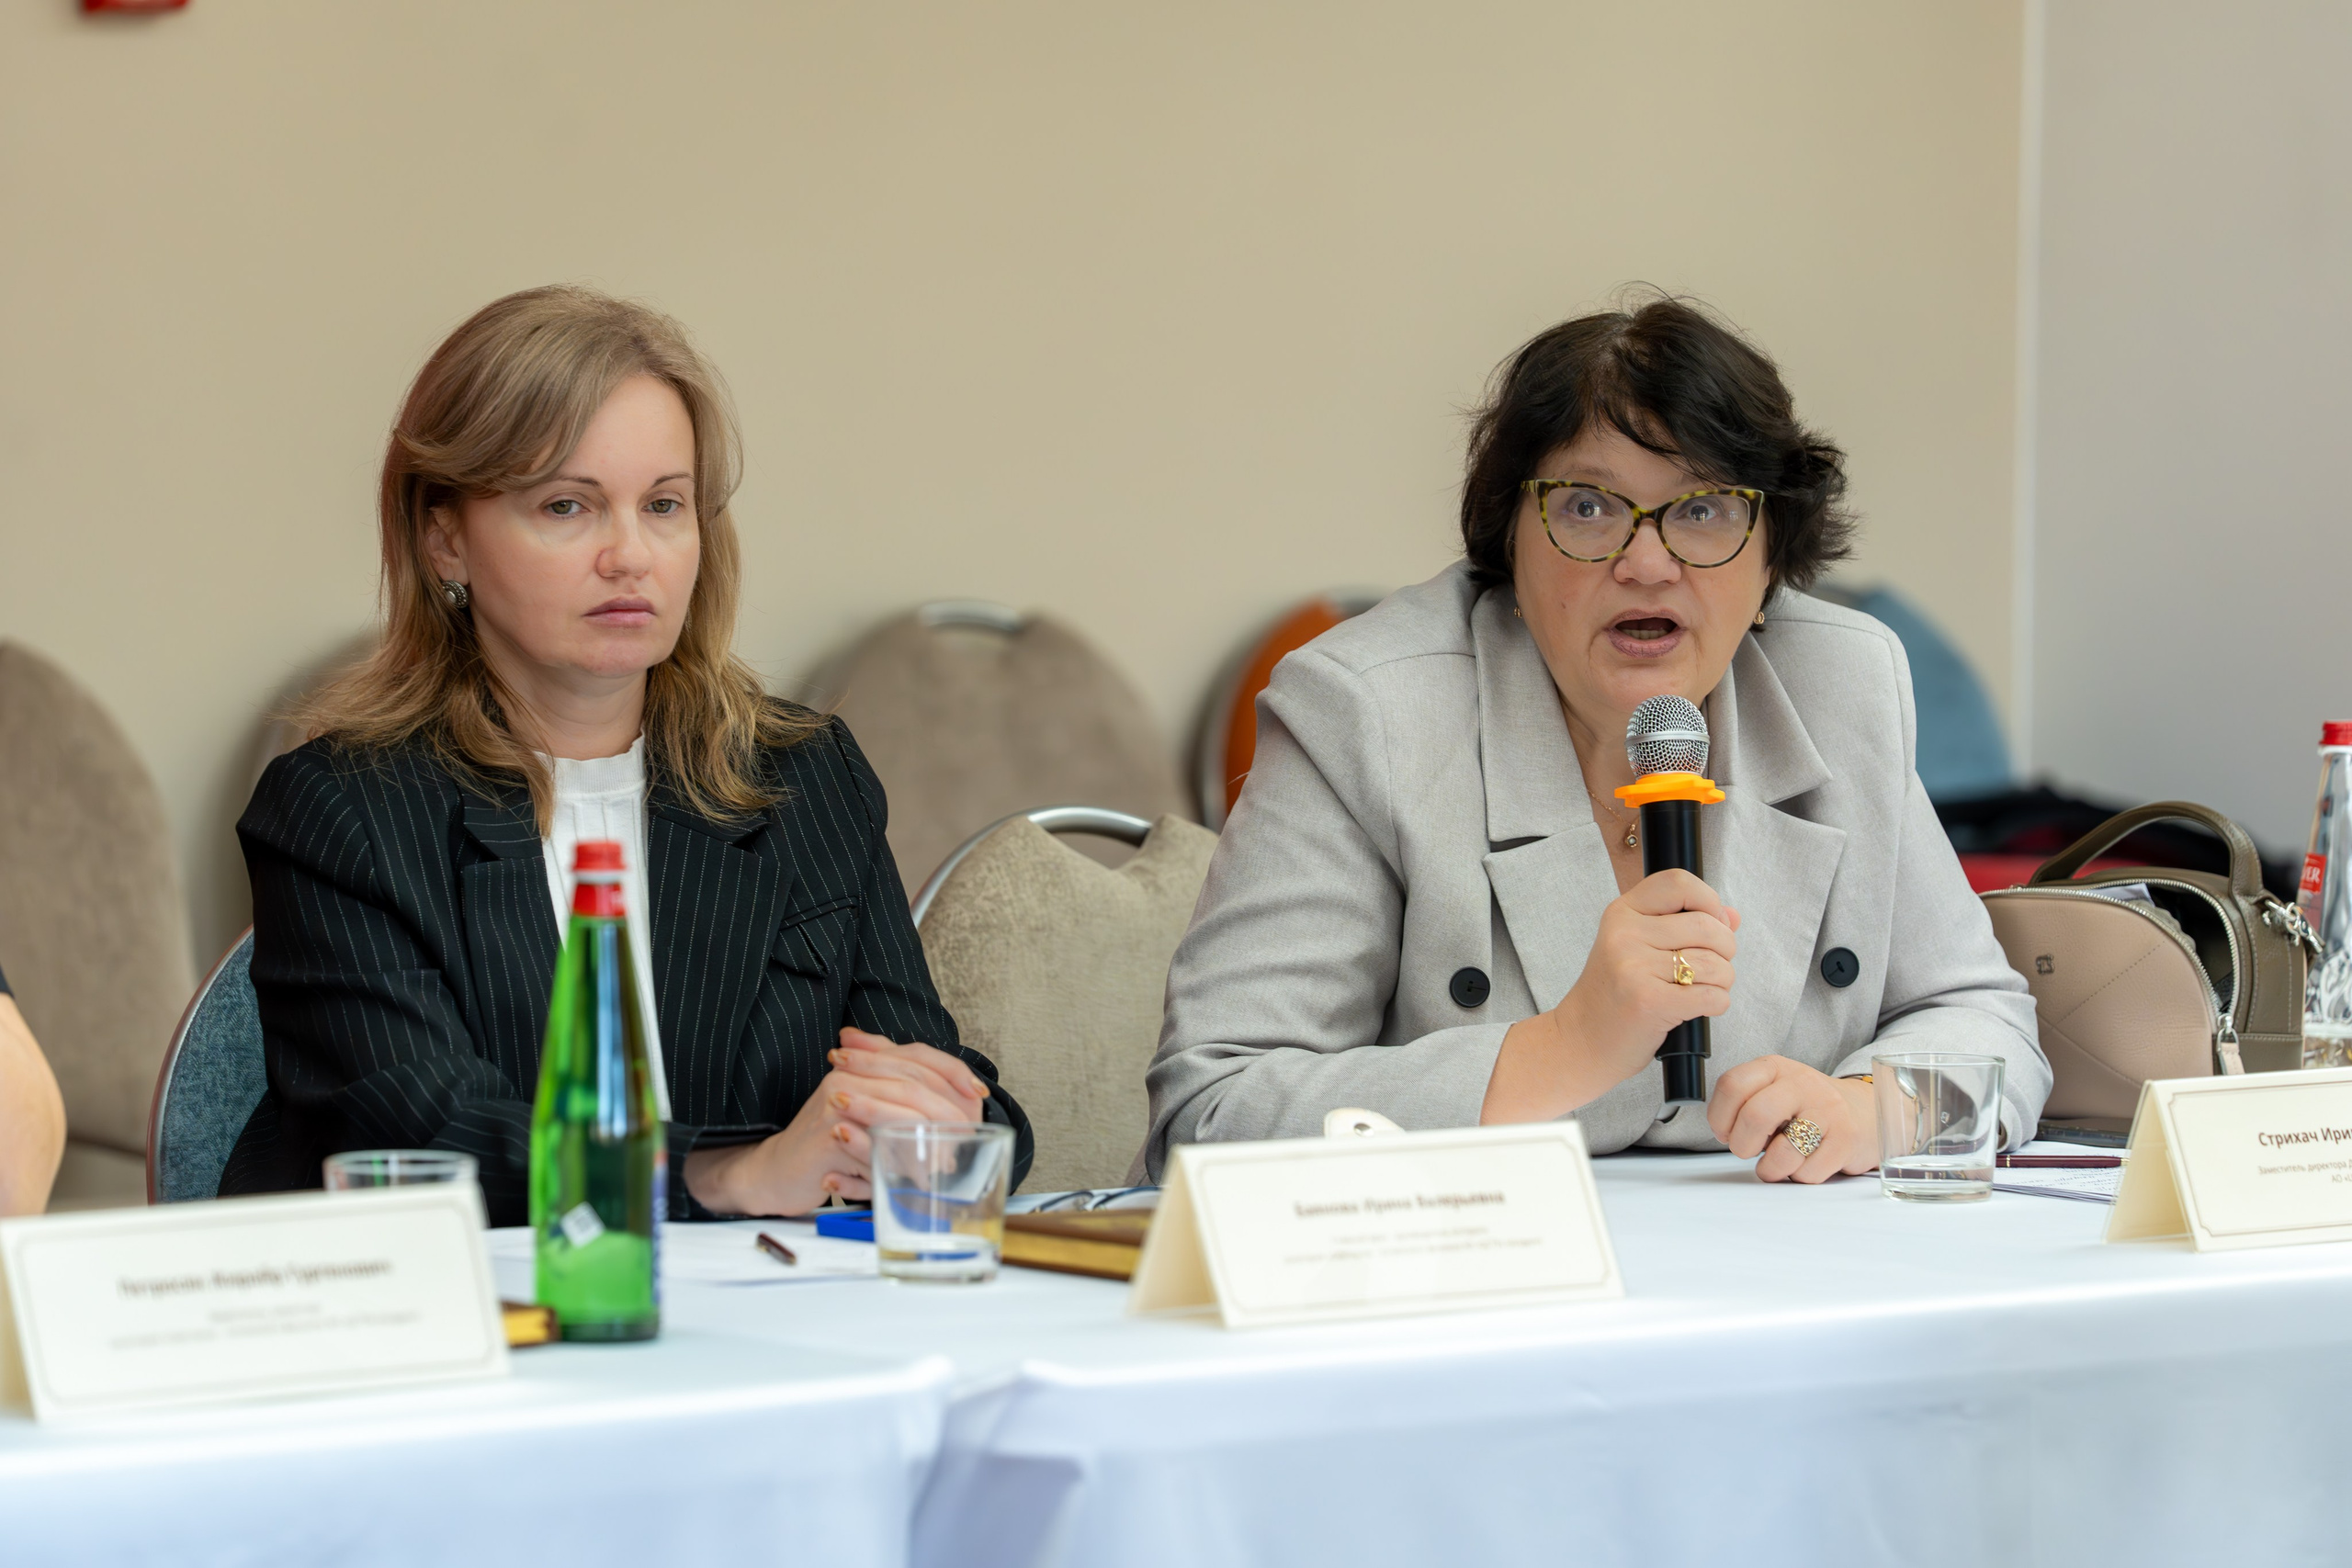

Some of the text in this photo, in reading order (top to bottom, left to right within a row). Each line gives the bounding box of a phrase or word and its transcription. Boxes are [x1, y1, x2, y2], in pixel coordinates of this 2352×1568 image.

[2258, 1127, 2352, 1149] Стрихач Ири
[2308, 1161, 2347, 1173] директора
